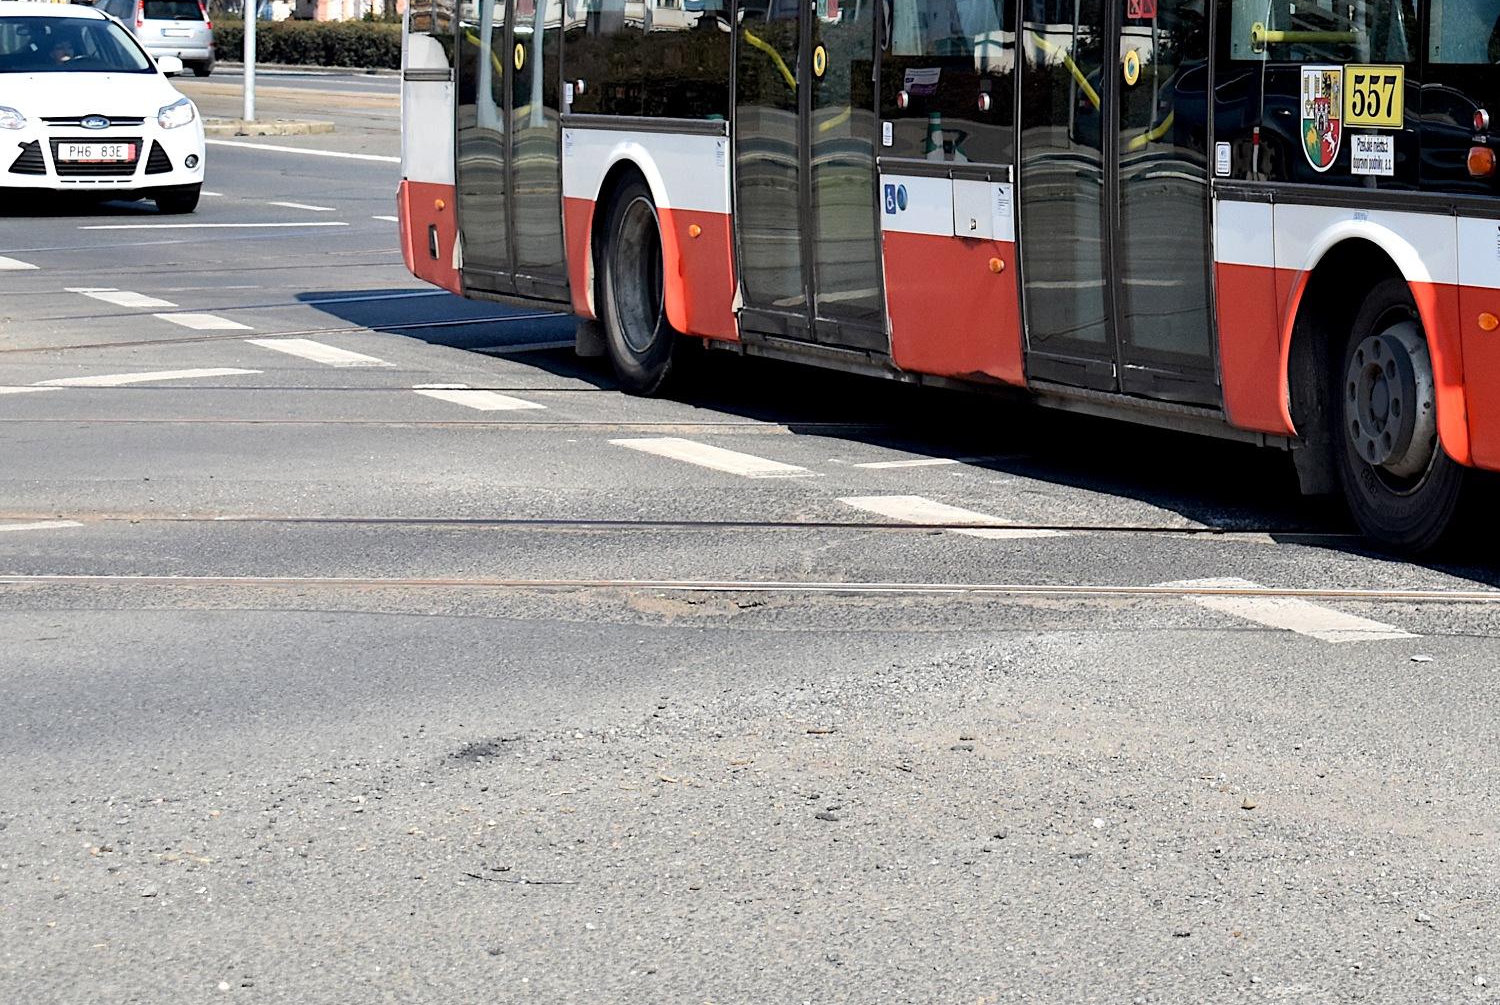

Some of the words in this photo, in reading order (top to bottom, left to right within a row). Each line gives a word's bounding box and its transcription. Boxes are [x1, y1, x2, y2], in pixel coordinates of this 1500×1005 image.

[1351, 74, 1397, 118] 557
[69, 146, 92, 158] PH6
[101, 146, 123, 158] 83E
